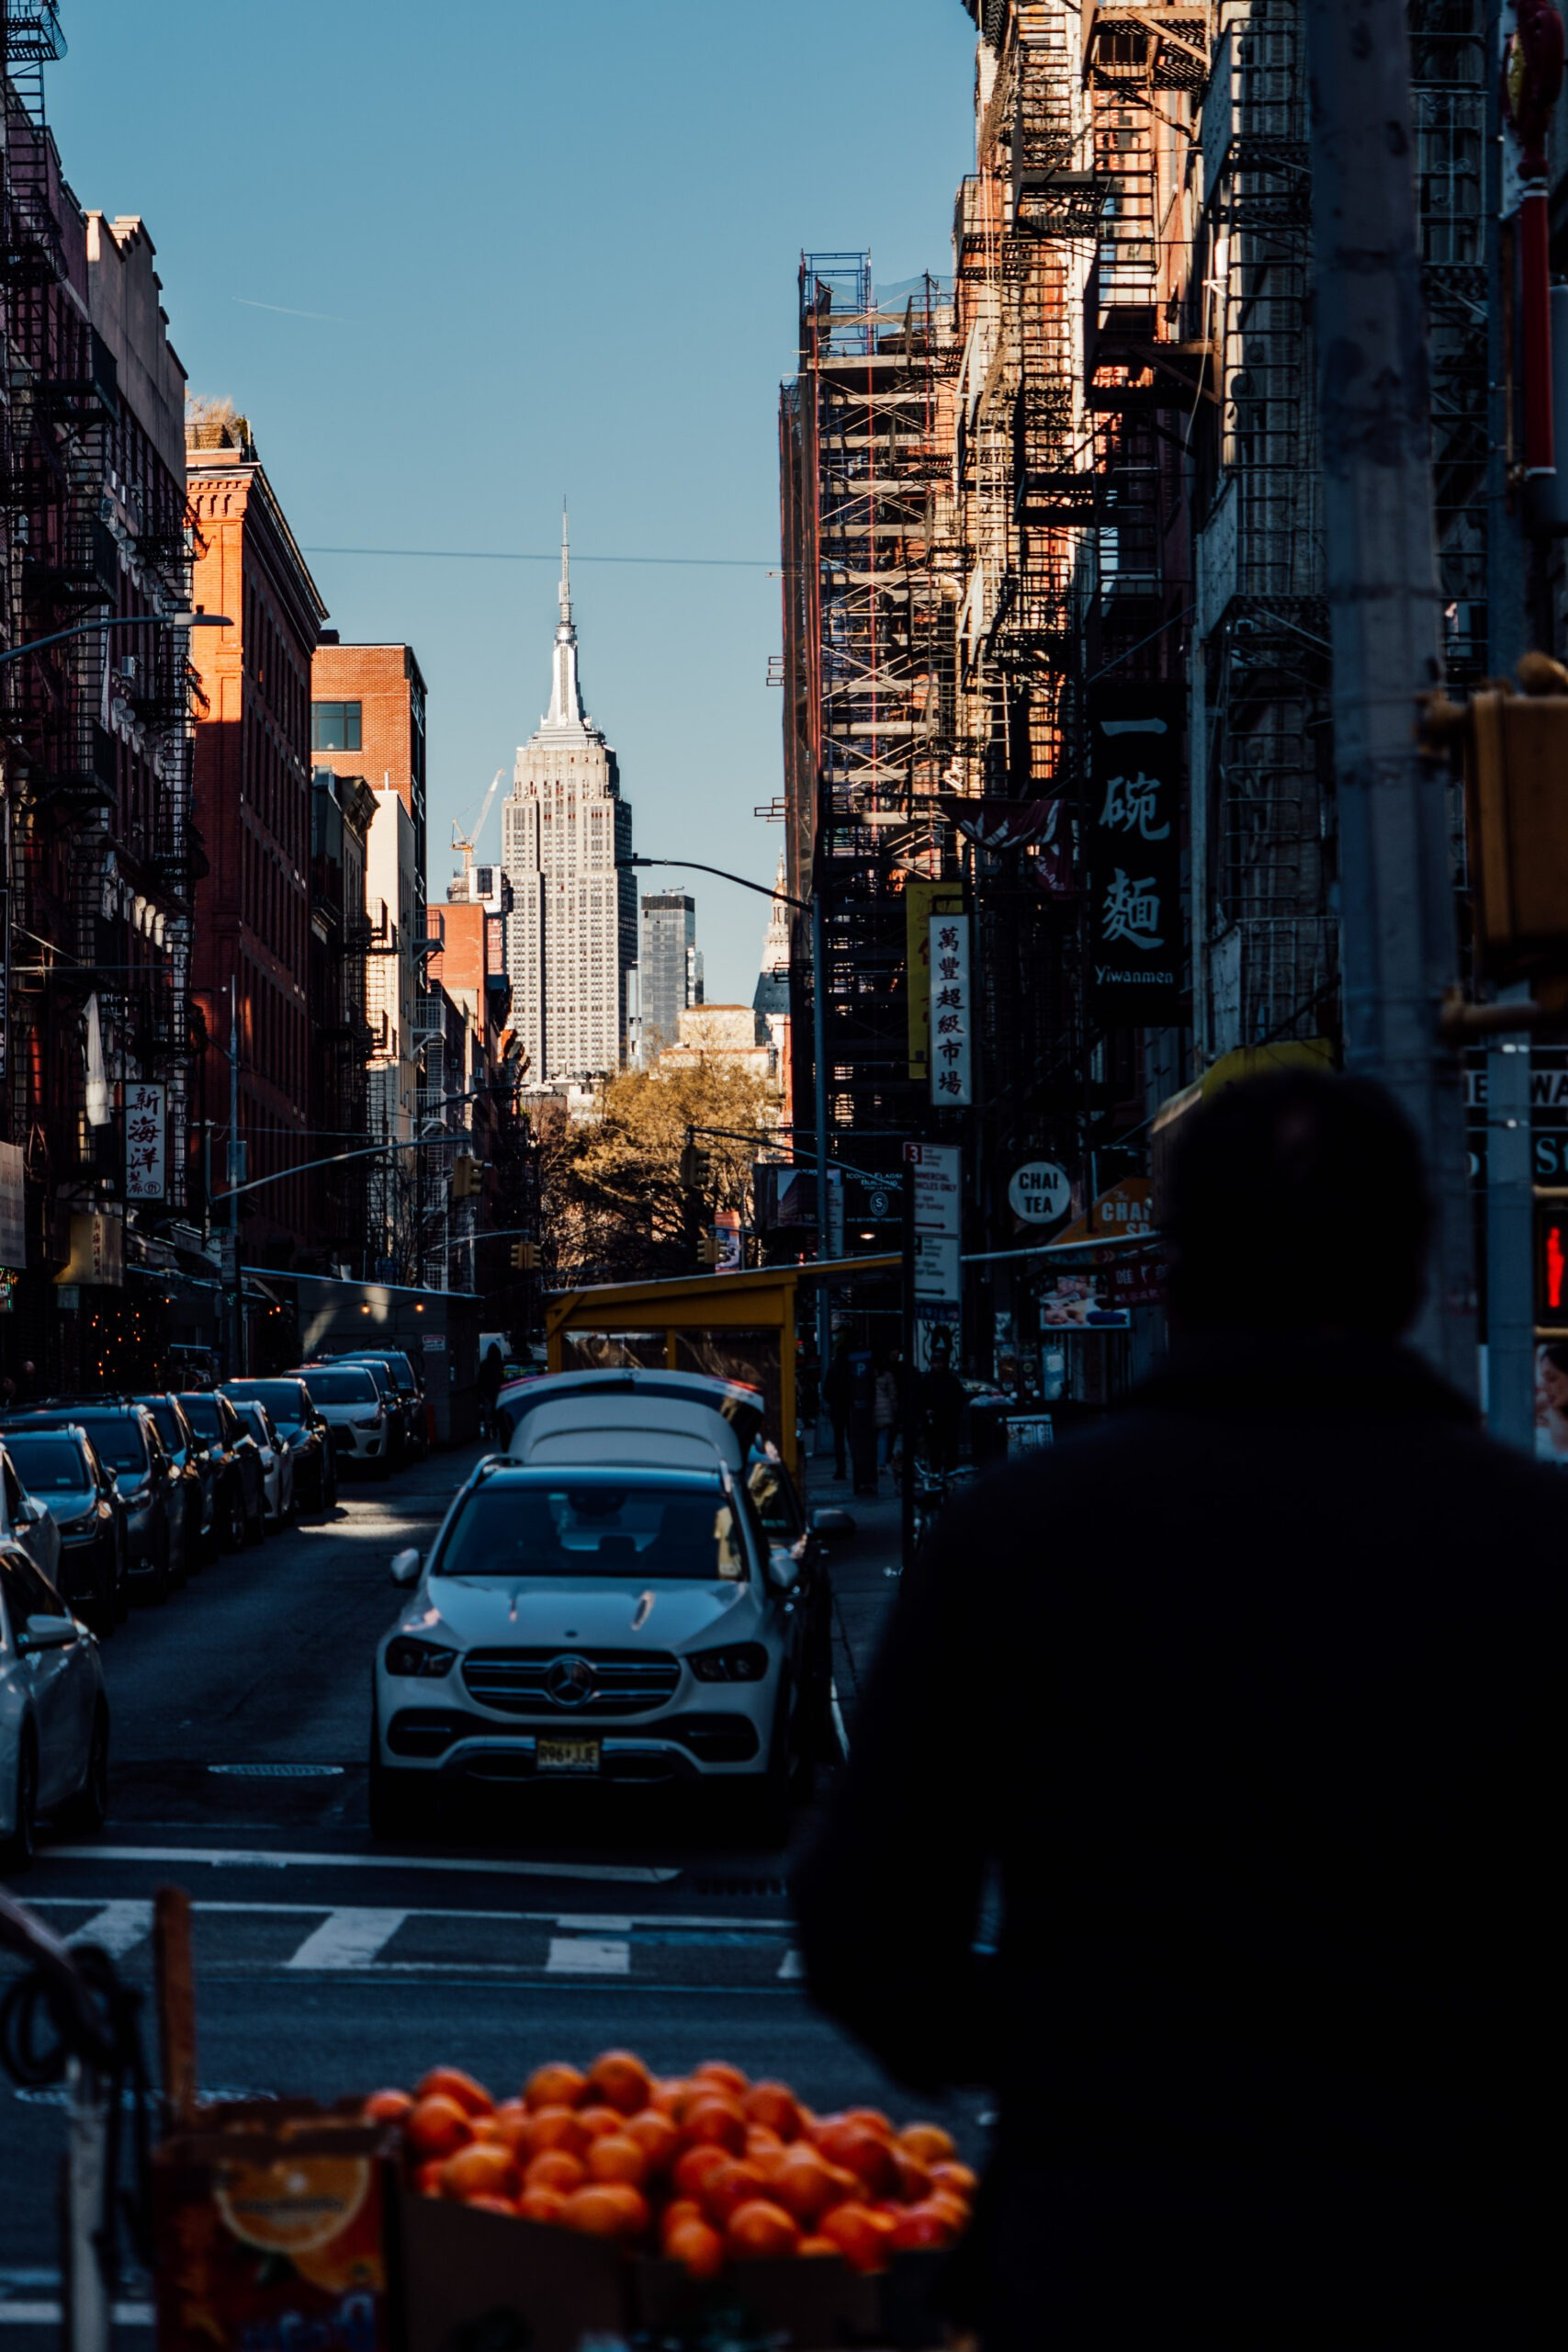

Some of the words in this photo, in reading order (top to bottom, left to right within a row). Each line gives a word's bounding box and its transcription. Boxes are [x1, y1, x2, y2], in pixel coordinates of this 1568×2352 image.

[1100, 718, 1170, 949] 一碗麵
[1094, 965, 1175, 984] Yiwanmen
[937, 927, 964, 1095] 萬豐超級市場
[1532, 1074, 1568, 1103] WA
[128, 1087, 162, 1173] 新海洋
[909, 1146, 919, 1162] 3
[1535, 1136, 1568, 1175] S
[1019, 1172, 1057, 1190] CHAI
[1024, 1196, 1053, 1213] TEA
[855, 1363, 866, 1376] P
